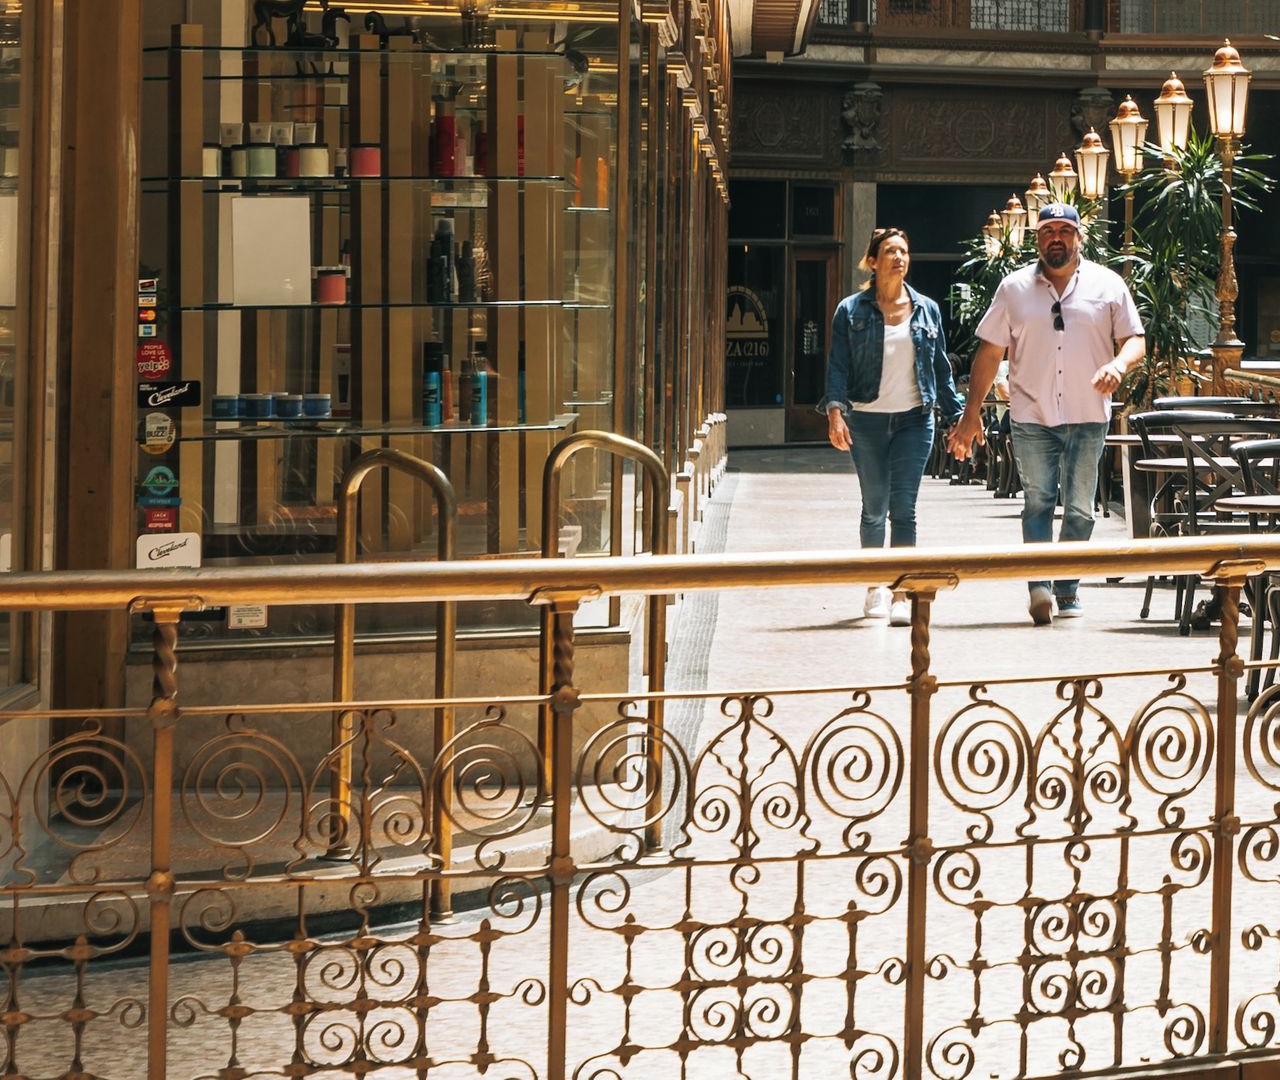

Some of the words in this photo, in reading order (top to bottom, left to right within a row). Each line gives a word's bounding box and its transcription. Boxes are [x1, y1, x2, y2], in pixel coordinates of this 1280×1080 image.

[138, 360, 160, 373] yelp
[148, 383, 190, 406] Cleveland
[148, 538, 189, 560] Cleveland
